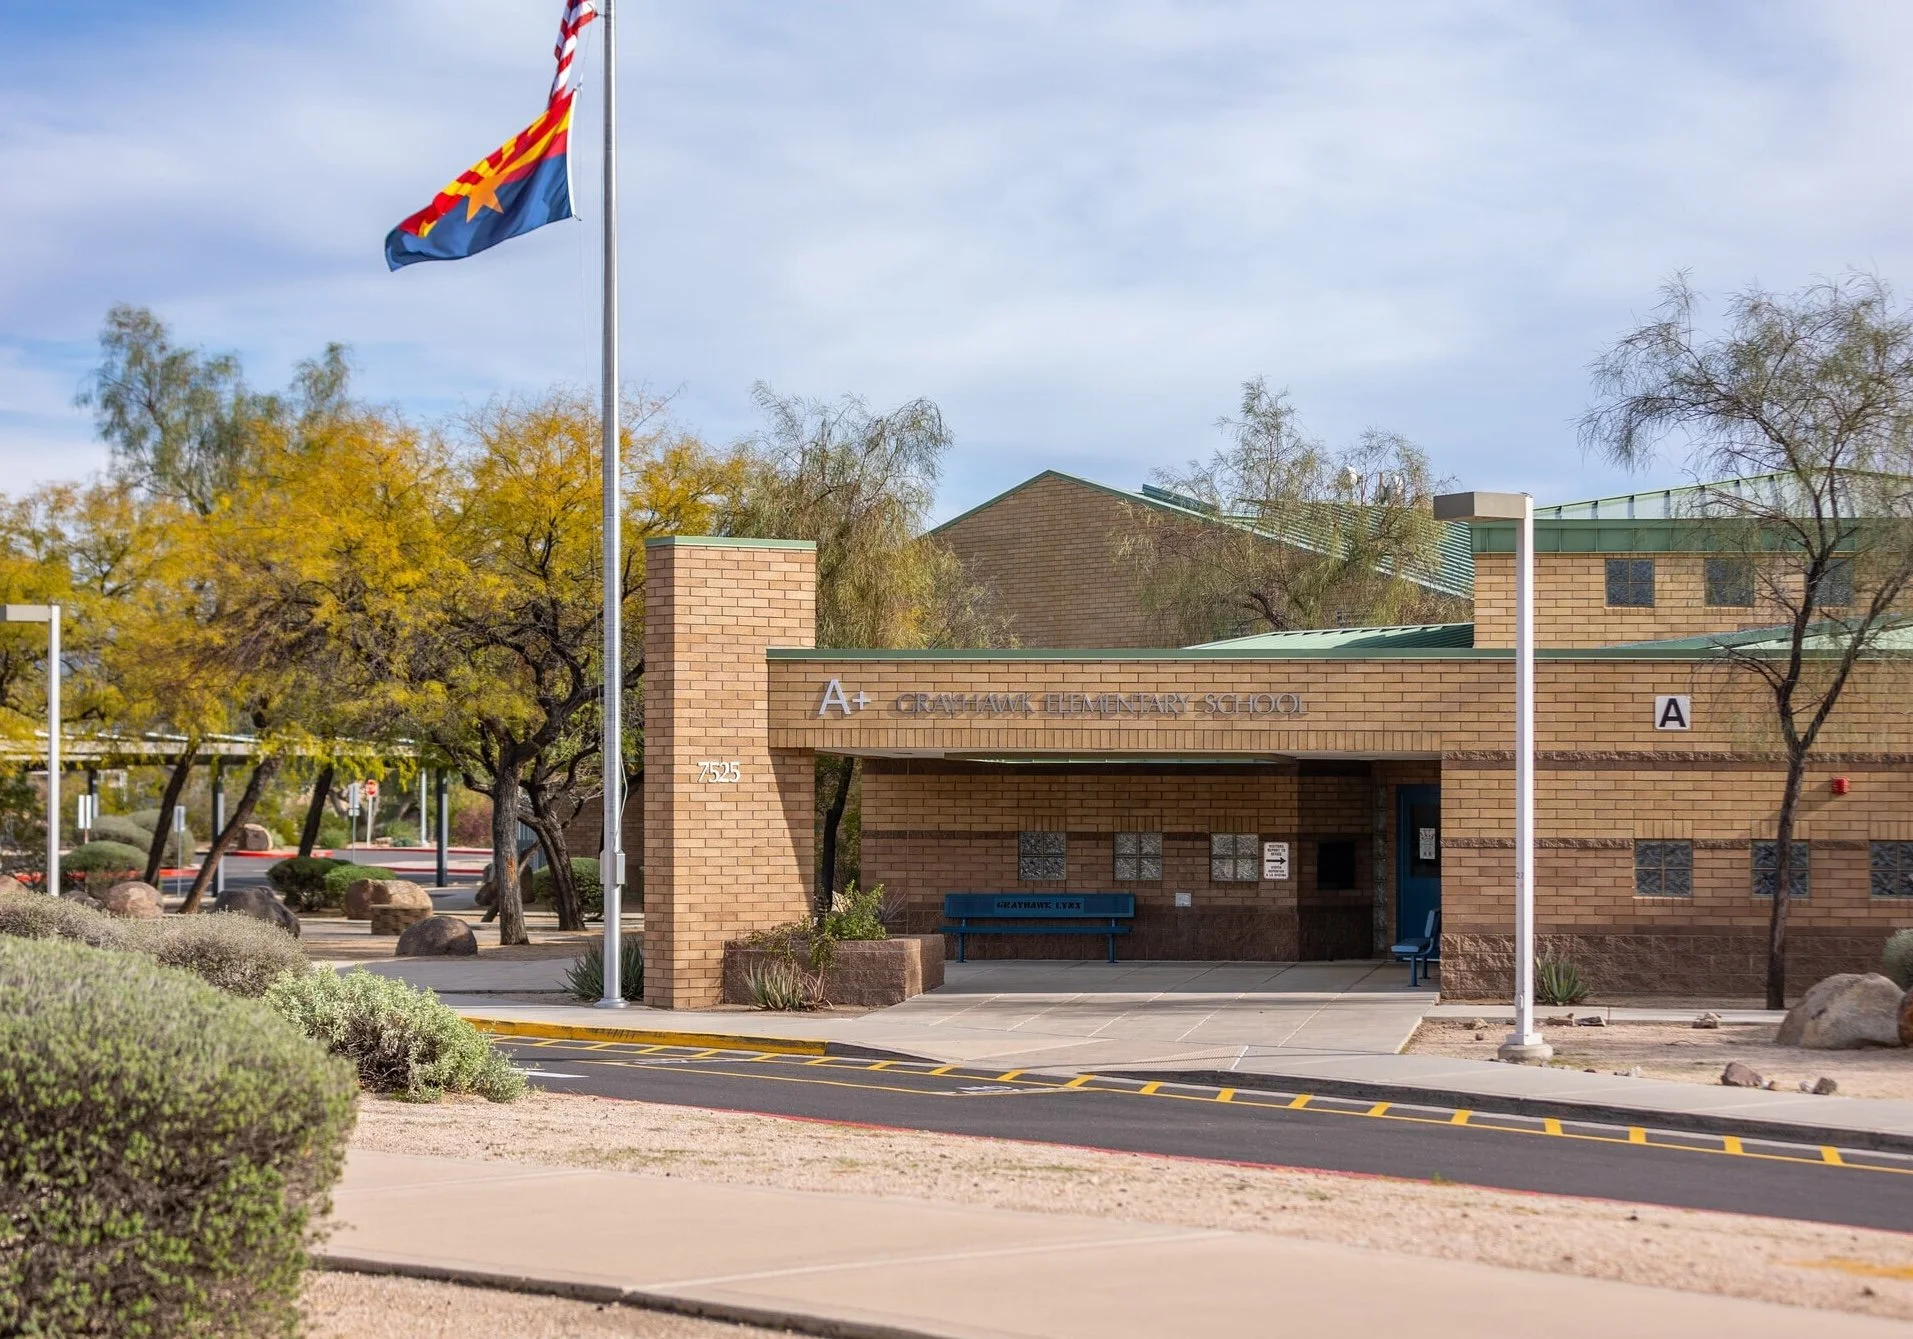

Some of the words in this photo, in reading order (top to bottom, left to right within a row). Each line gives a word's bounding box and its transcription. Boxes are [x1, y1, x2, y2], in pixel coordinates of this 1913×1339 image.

[897, 693, 1036, 714] GRAYHAWK
[1046, 693, 1193, 715] ELEMENTARY
[1204, 693, 1310, 715] SCHOOL
[1658, 697, 1687, 728] A
[696, 761, 741, 783] 7525
[996, 901, 1052, 909] GRAYHAWK
[1055, 901, 1082, 909] LYNX
